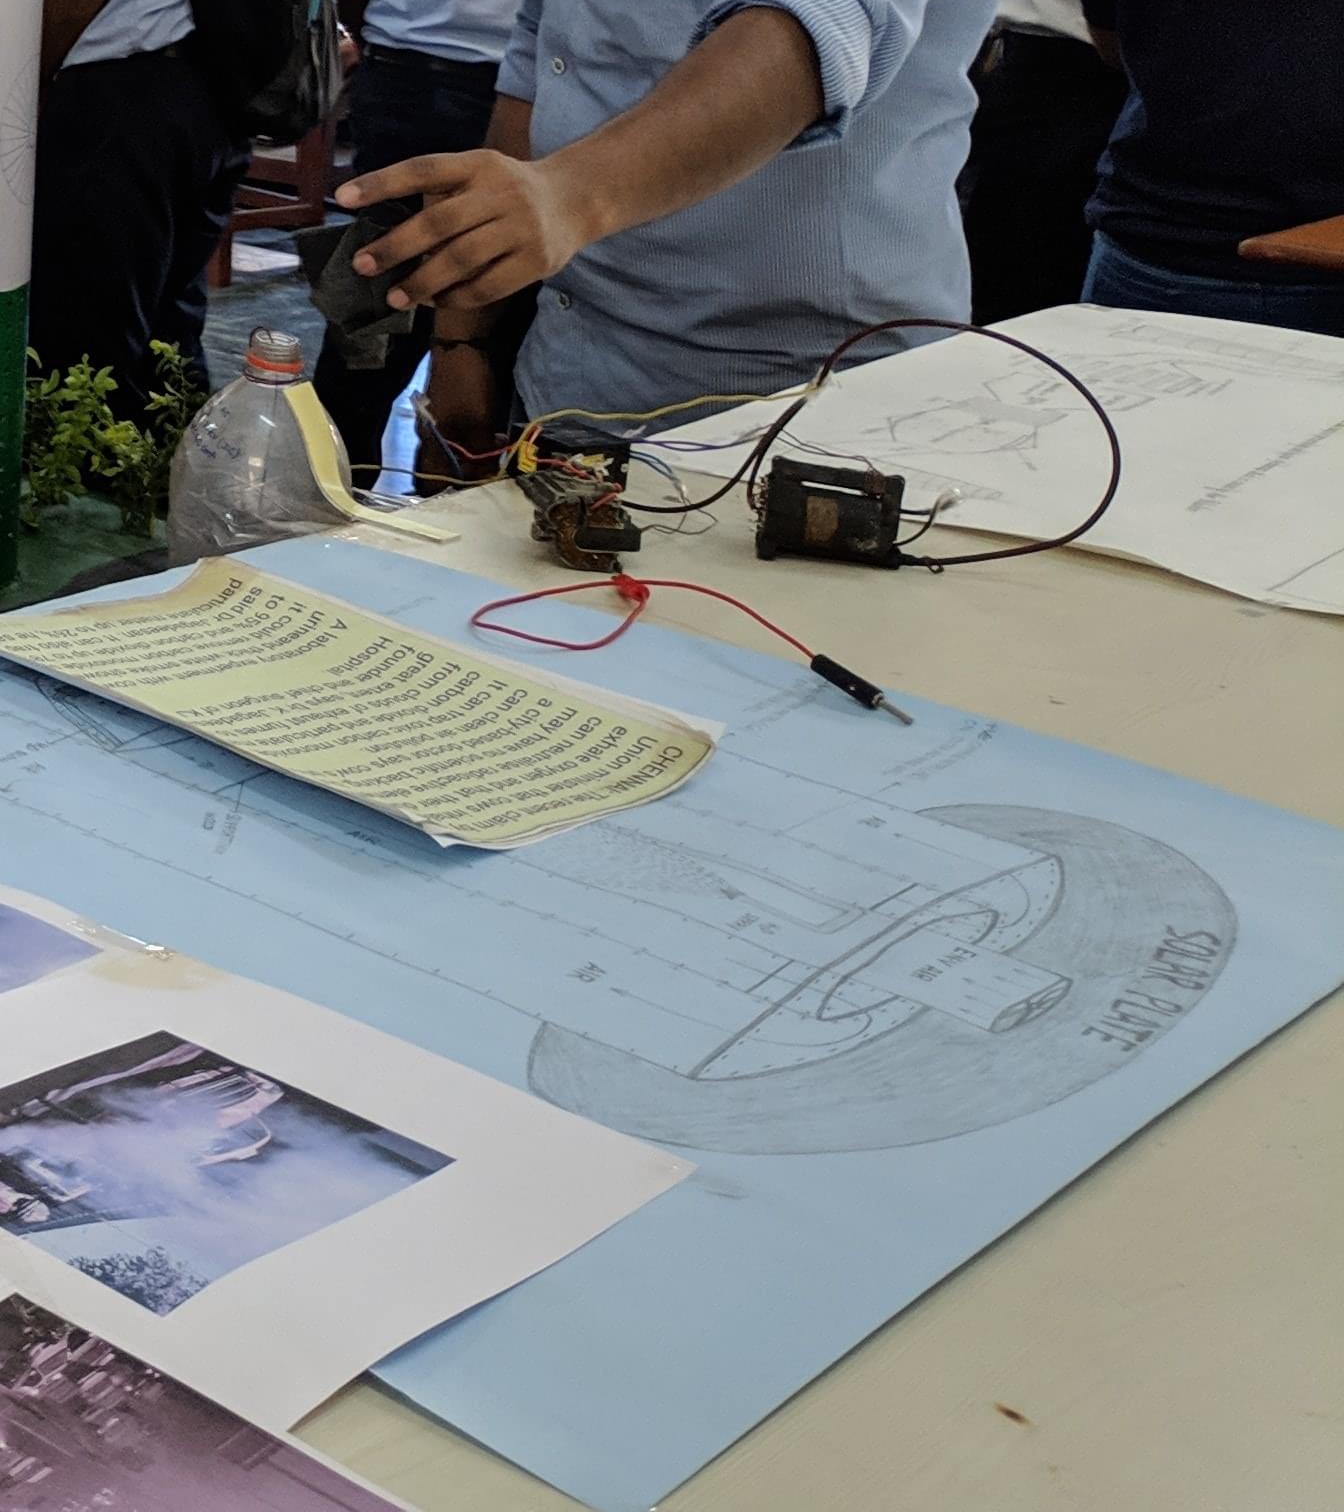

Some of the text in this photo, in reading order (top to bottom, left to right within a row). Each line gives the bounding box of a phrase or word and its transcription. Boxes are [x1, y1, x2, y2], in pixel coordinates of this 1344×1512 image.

[565, 961, 607, 982] AIR
[1081, 924, 1221, 1052] SOLAR PLATE
